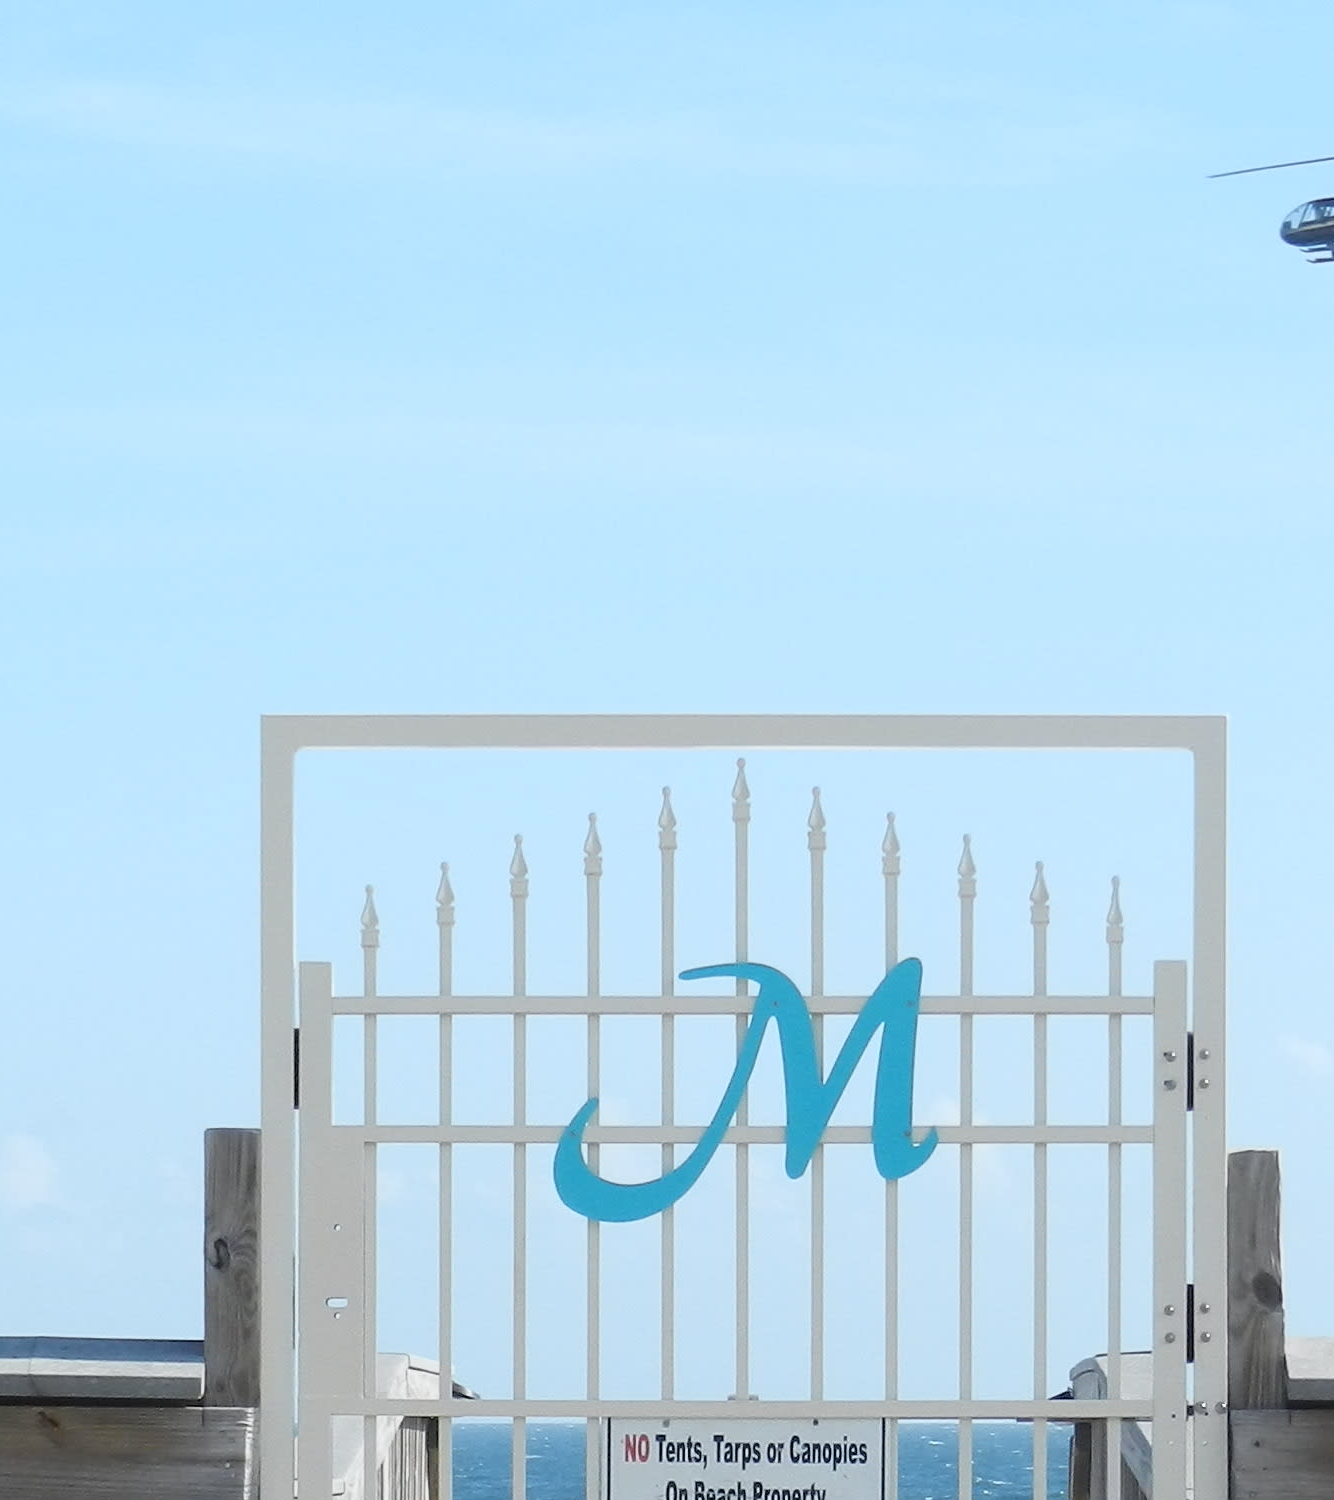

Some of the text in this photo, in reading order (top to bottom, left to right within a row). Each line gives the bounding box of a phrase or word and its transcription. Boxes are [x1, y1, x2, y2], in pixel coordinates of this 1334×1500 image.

[553, 956, 939, 1222] M
[624, 1433, 868, 1472] NO Tents, Tarps or Canopies
